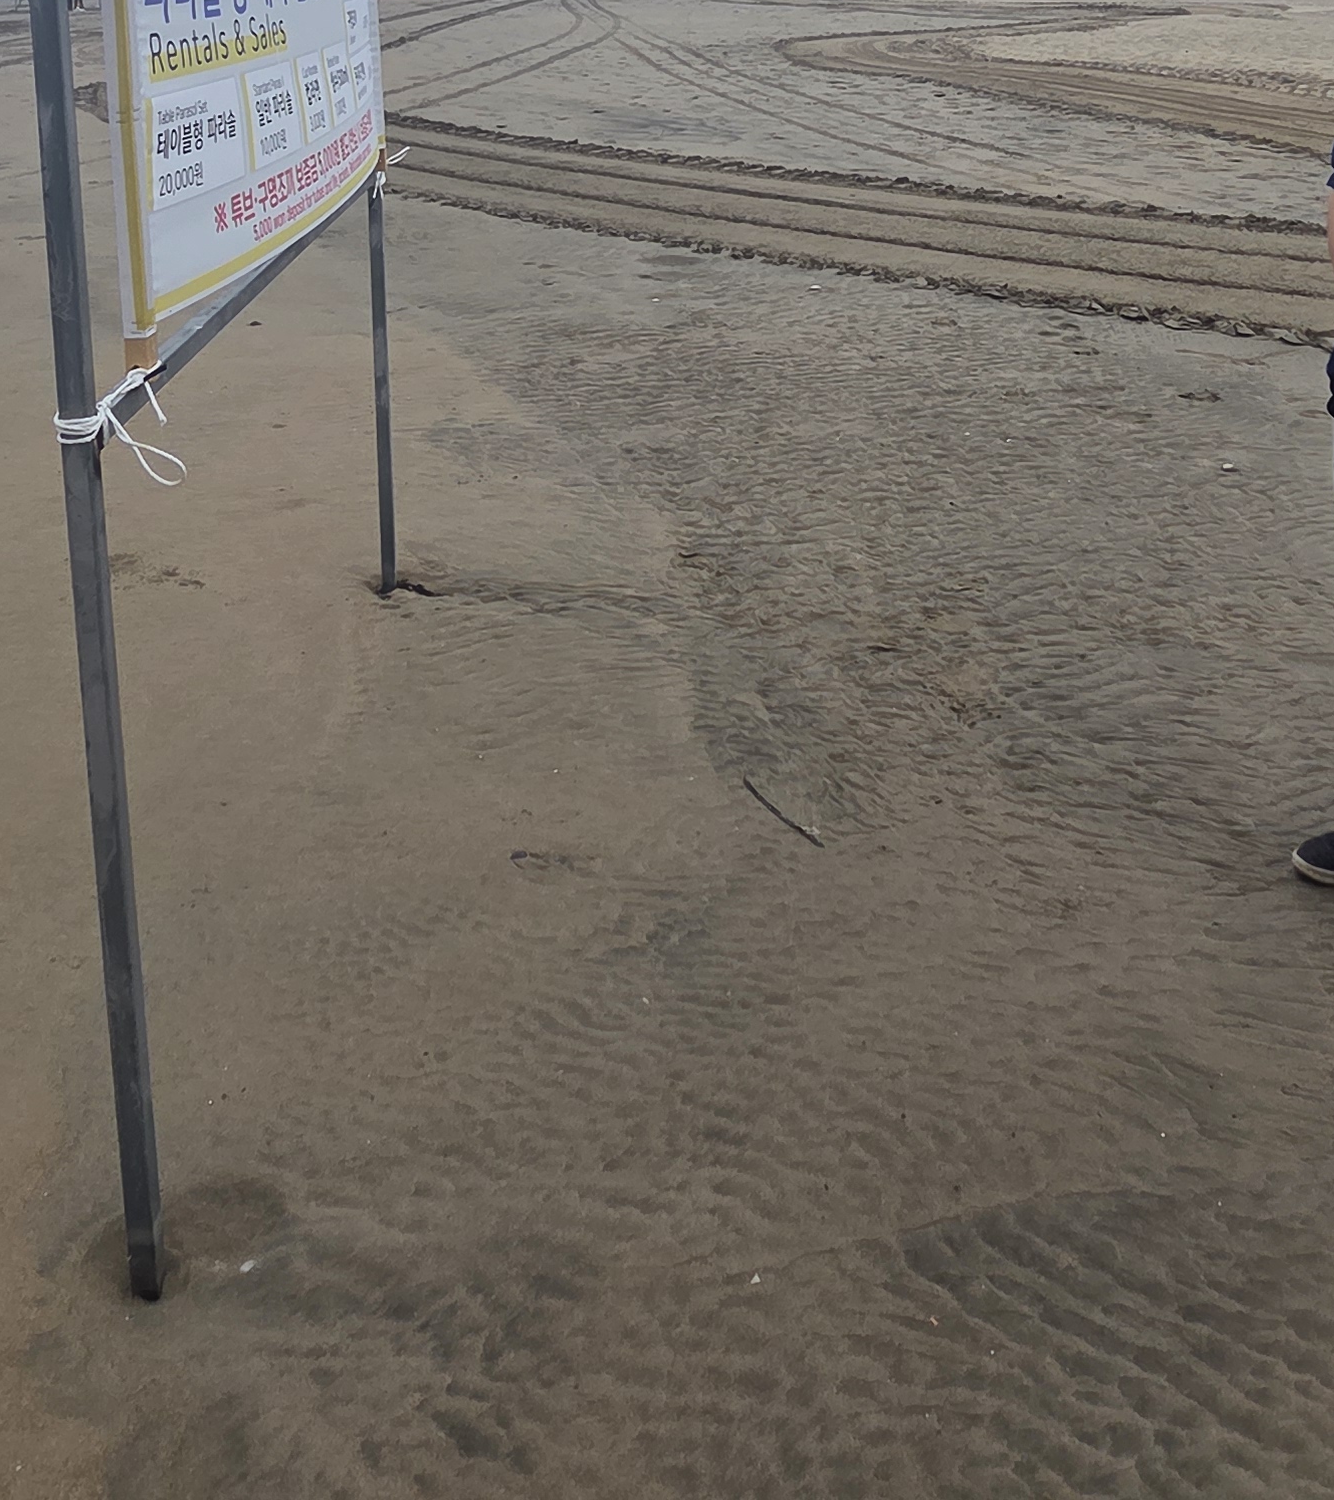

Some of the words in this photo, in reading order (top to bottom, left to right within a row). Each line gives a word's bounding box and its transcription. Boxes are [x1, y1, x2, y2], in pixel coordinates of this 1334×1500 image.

[149, 22, 228, 74] Rentals
[234, 19, 245, 56] &
[249, 13, 287, 52] Sales
[272, 89, 294, 118] 파라솔
[157, 119, 204, 159] 테이블형
[207, 109, 236, 143] 파라솔
[159, 161, 203, 197] 20,000원
[295, 153, 318, 192] 보증금
